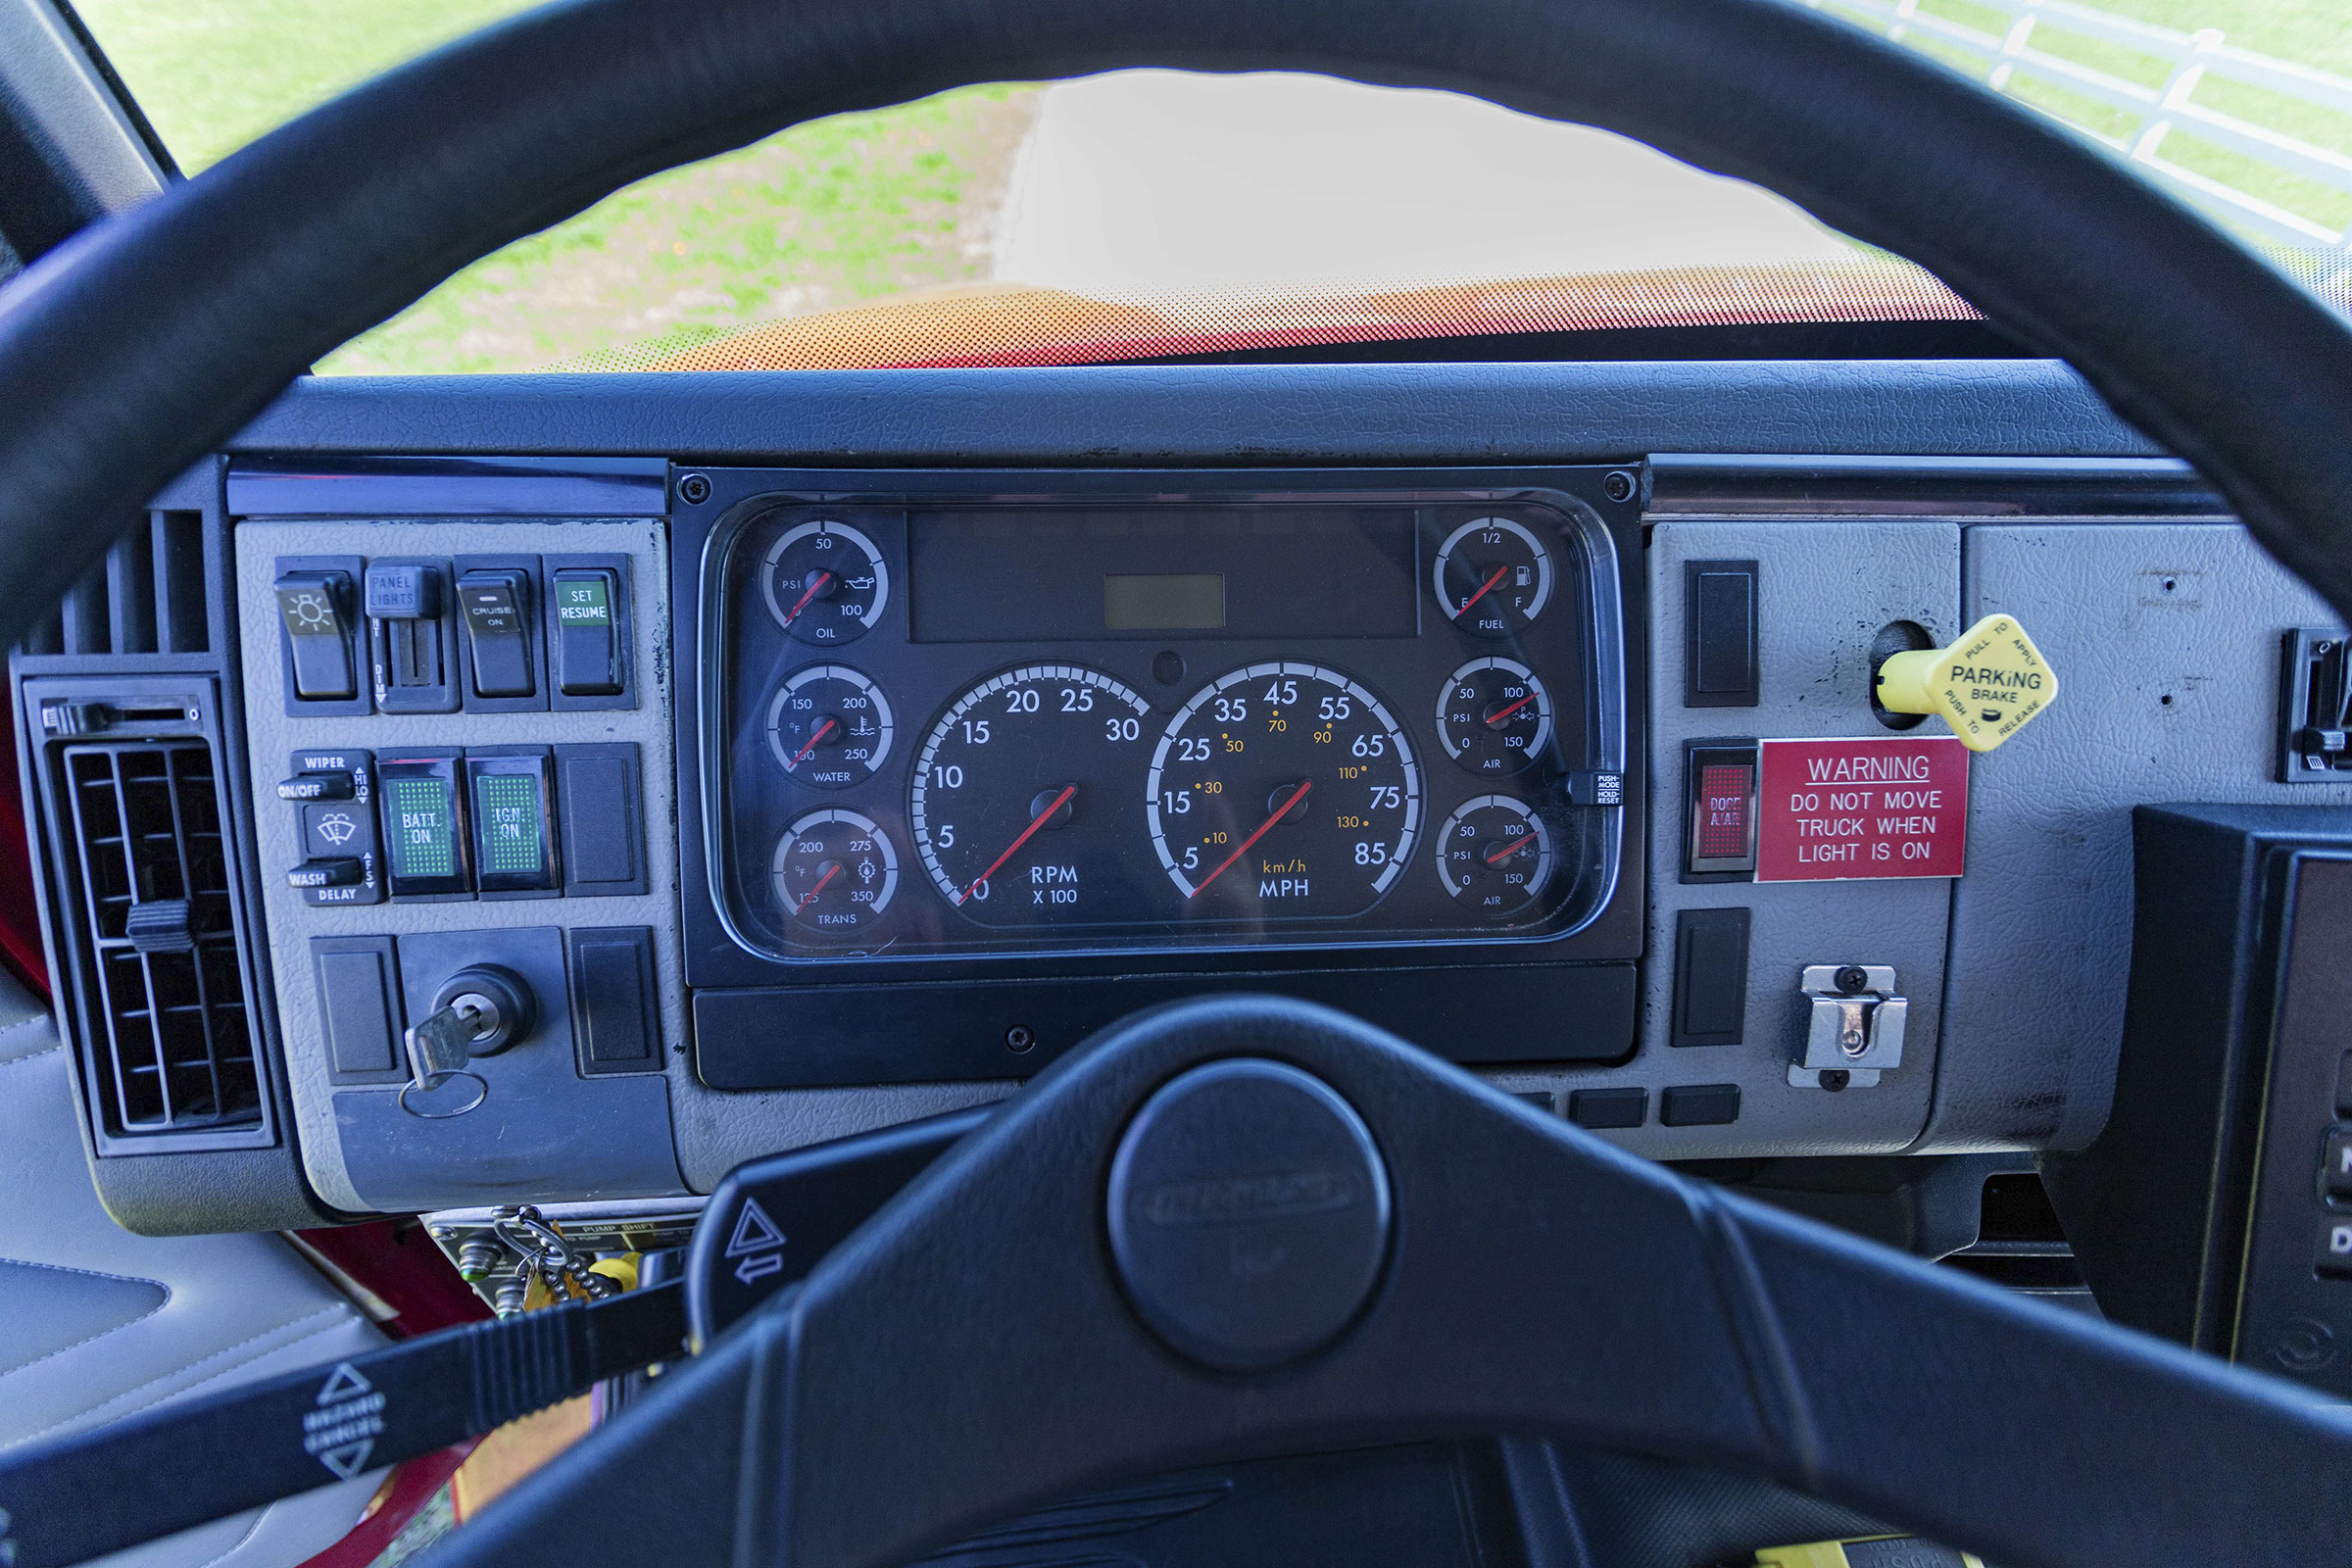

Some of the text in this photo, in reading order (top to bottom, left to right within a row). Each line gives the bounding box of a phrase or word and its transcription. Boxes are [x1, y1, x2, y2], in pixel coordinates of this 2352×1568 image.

[1483, 532, 1500, 544] 1/2
[815, 539, 832, 550] 50
[372, 576, 412, 588] PANEL
[782, 579, 801, 589] PSI
[370, 593, 414, 606] LIGHTS
[571, 590, 592, 602] SET
[1515, 597, 1521, 608] F
[472, 607, 511, 615] CRUISE
[561, 606, 607, 618] RESUME
[841, 605, 862, 615] 100
[1479, 620, 1503, 629] FUEL
[816, 628, 835, 638] OIL
[1965, 623, 2037, 666] PULL TO APPLY
[375, 664, 385, 693] DIM
[1263, 680, 1298, 705] 45
[1459, 688, 1474, 699] 50
[1504, 687, 1524, 698] 100
[1971, 688, 2018, 704] BRAKE
[792, 699, 812, 710] 150
[843, 698, 866, 709] 200
[1005, 690, 1040, 712] 20
[1060, 688, 1094, 712] 25
[1214, 698, 1247, 722] 35
[1318, 697, 1350, 720] 55
[1944, 690, 2039, 736] PUSH TO RELEASE
[1453, 713, 1470, 722] PSI
[1105, 718, 1140, 741] 30
[1268, 719, 1287, 732] 70
[962, 720, 990, 744] 15
[1313, 731, 1332, 744] 90
[1225, 740, 1244, 753] 50
[1351, 734, 1384, 758] 65
[1462, 737, 1470, 749] 0
[1504, 737, 1523, 748] 150
[845, 749, 867, 760] 250
[1178, 738, 1210, 761] 25
[305, 758, 345, 768] WIPER
[1483, 760, 1501, 768] AIR
[1808, 756, 1930, 781] WARNING
[813, 771, 851, 782] WATER
[935, 765, 963, 789] 10
[1339, 767, 1358, 779] 110
[354, 774, 367, 785] HI
[277, 785, 321, 797] ON/OFF
[356, 786, 368, 797] LO
[1204, 781, 1222, 794] 30
[1164, 791, 1191, 814] 15
[1370, 786, 1400, 809] 75
[1790, 791, 1941, 812] DO NOT MOVE
[403, 812, 441, 828] BATT.
[495, 808, 525, 822] IGN.
[1337, 816, 1359, 828] 130
[1796, 816, 1936, 837] TRUCK WHEN
[501, 823, 519, 838] ON
[1460, 826, 1475, 837] 50
[1504, 825, 1524, 835] 100
[412, 829, 431, 844] ON
[938, 825, 954, 848] 5
[1213, 832, 1227, 844] 10
[799, 841, 823, 853] 200
[850, 841, 871, 852] 275
[1798, 842, 1930, 863] LIGHT IS ON
[1183, 847, 1199, 869] 5
[1354, 842, 1386, 865] 85
[1453, 852, 1471, 860] PSI
[366, 860, 371, 870] F
[1263, 859, 1306, 873] km/h
[289, 873, 326, 886] WASH
[366, 871, 373, 881] S
[1031, 865, 1078, 883] RPM
[1462, 874, 1470, 886] 0
[1504, 873, 1523, 884] 150
[972, 878, 990, 901] 0
[1259, 879, 1309, 898] MPH
[318, 889, 357, 901] DELAY
[851, 891, 873, 902] 350
[1052, 890, 1078, 904] 100
[1484, 896, 1501, 906] AIR
[817, 913, 857, 924] TRANS
